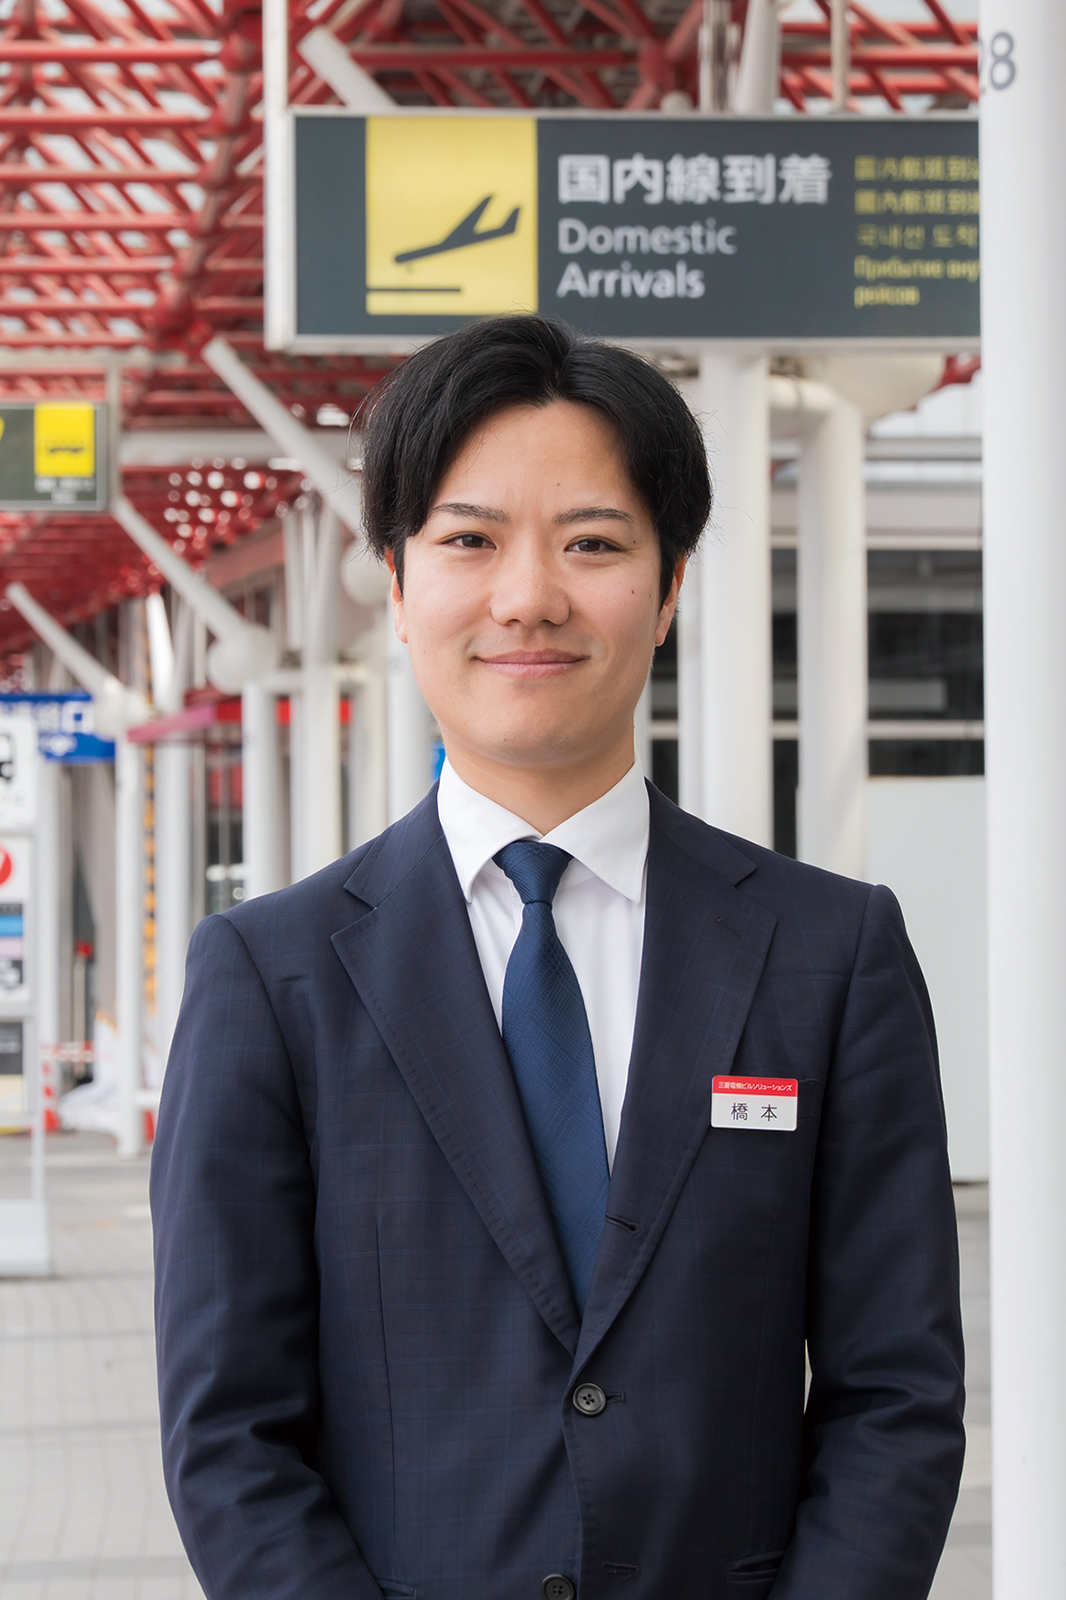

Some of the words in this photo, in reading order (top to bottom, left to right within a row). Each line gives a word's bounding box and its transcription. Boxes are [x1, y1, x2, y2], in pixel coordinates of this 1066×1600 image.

[558, 154, 831, 205] 国内線到着
[558, 217, 737, 254] Domestic
[557, 260, 705, 298] Arrivals
[718, 1081, 792, 1091] 三菱電機ビルソリューションズ
